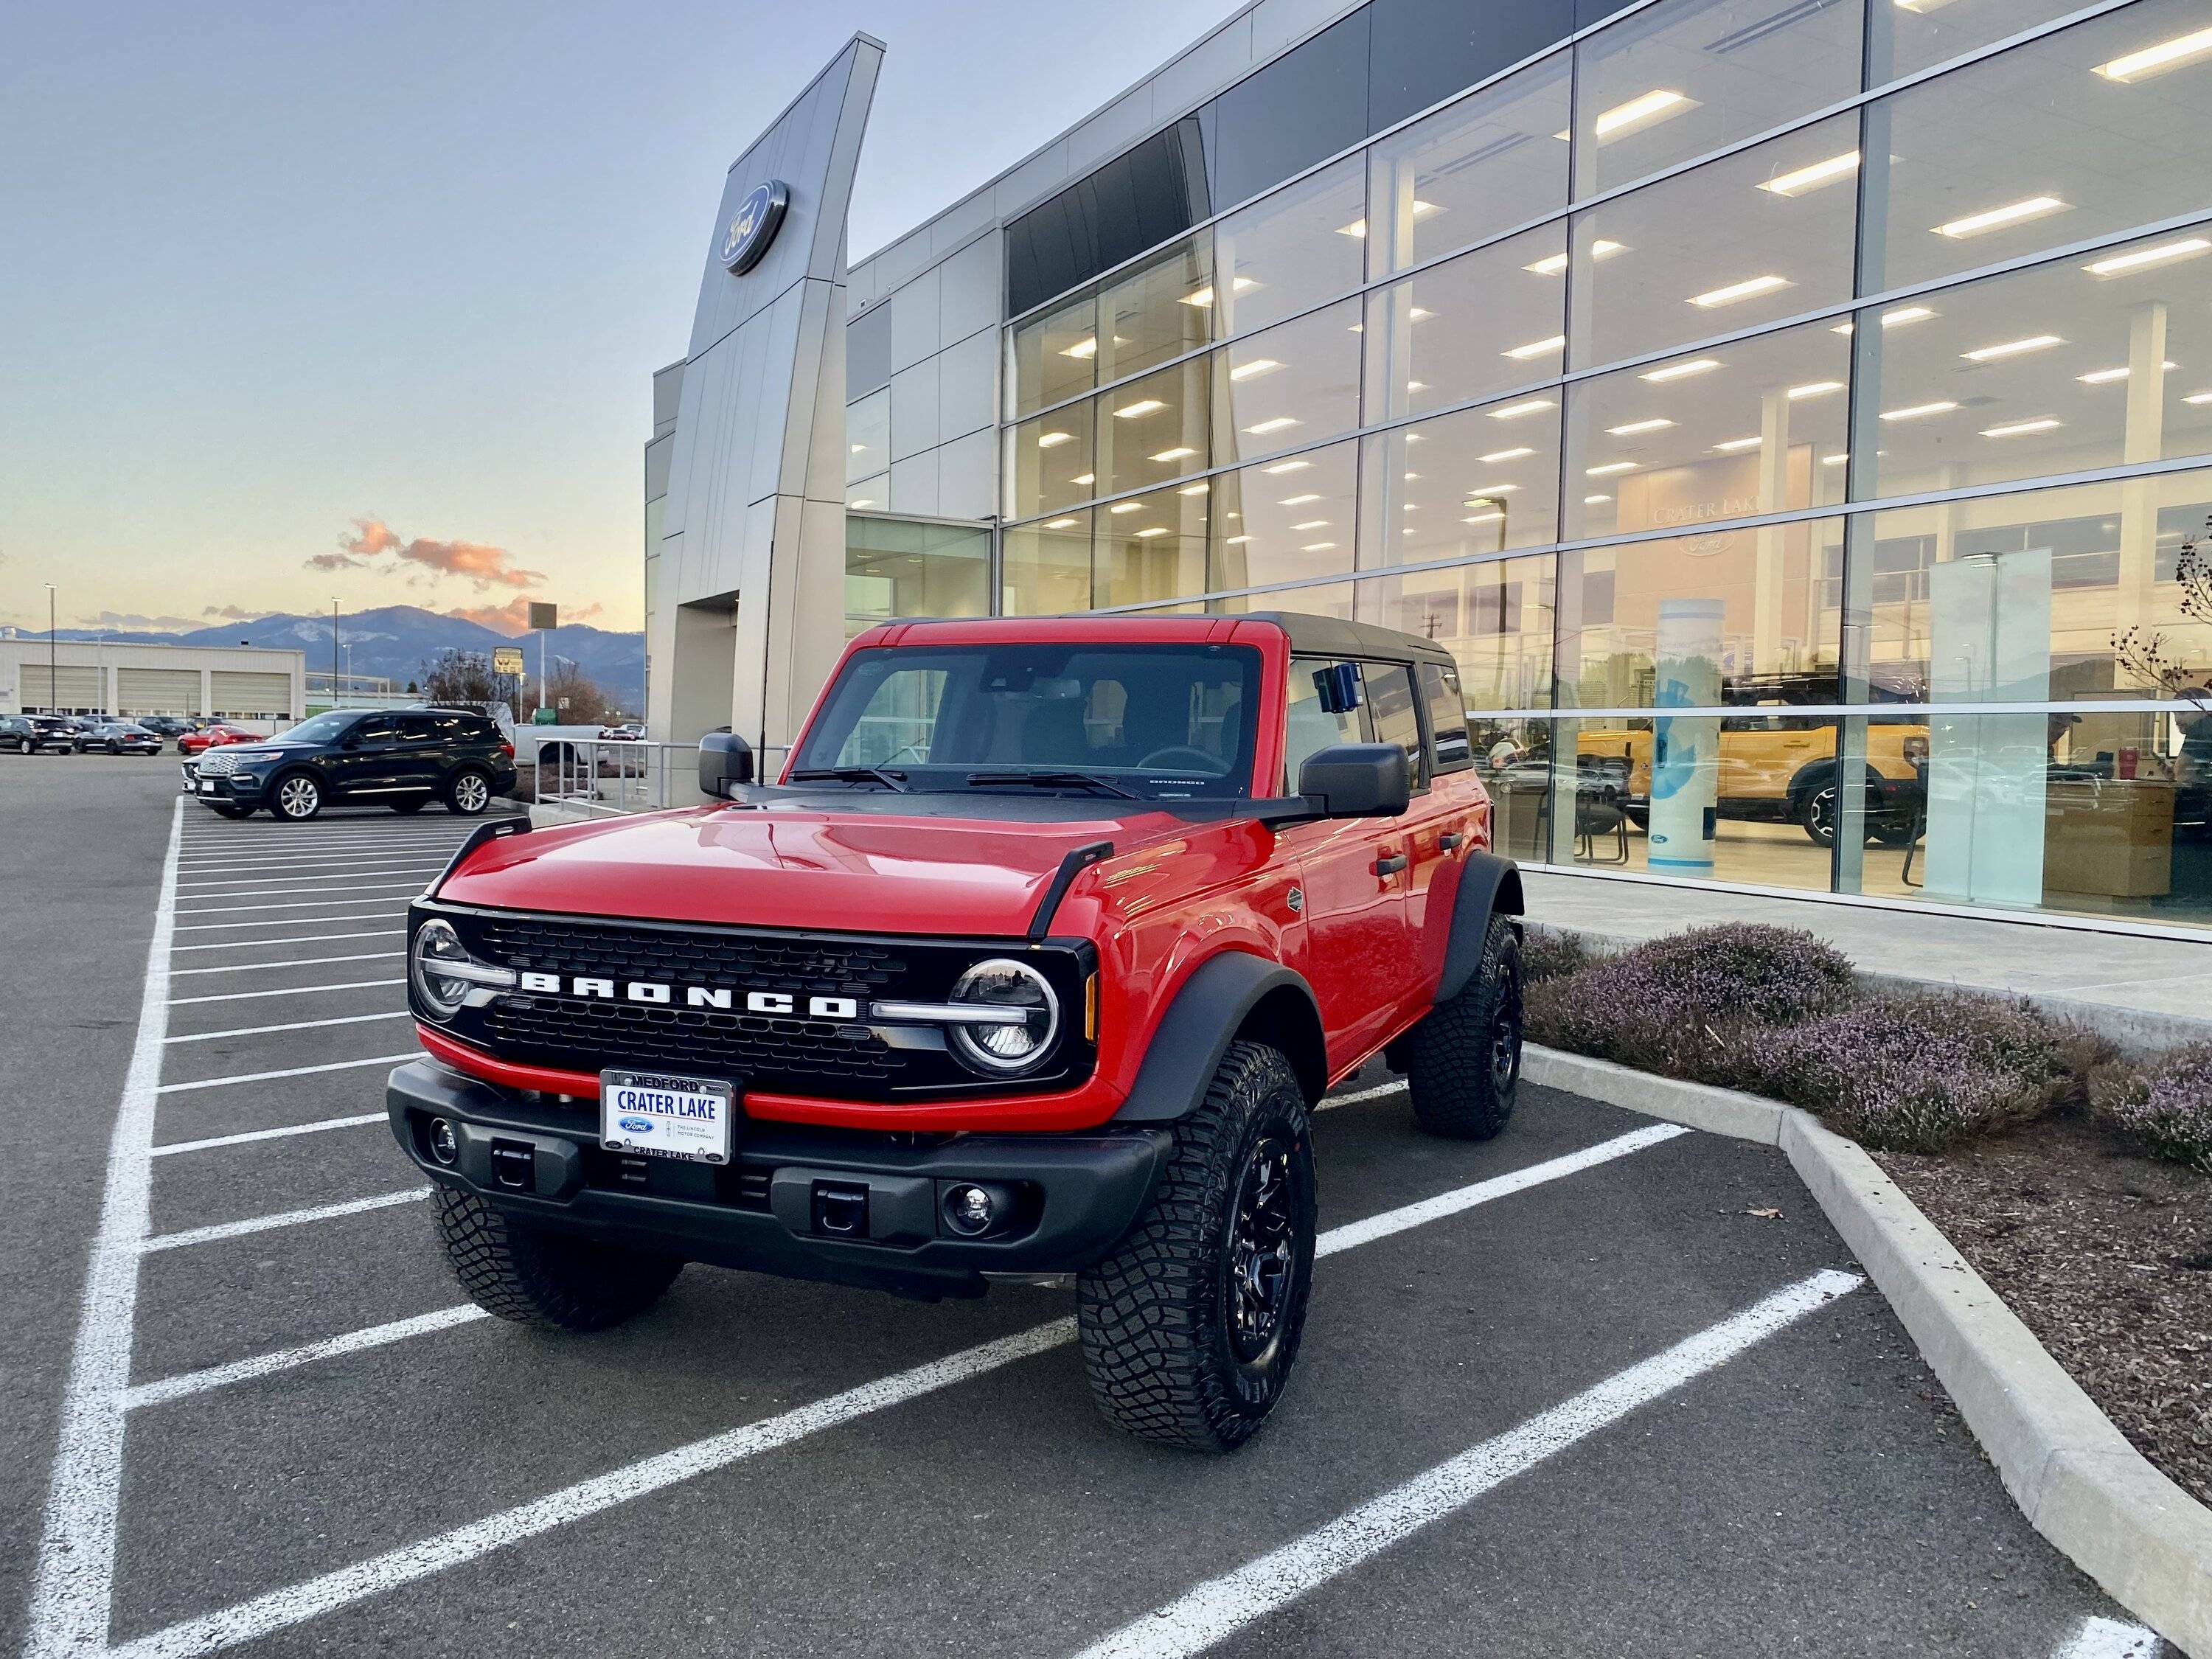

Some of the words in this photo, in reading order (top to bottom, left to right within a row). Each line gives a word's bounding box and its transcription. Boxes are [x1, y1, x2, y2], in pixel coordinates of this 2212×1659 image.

[724, 200, 759, 256] Ford
[1653, 502, 1717, 524] CRATER
[521, 972, 857, 1018] BRONCO
[631, 1074, 699, 1092] MEDFORD
[617, 1091, 674, 1115] CRATER
[678, 1096, 715, 1119] LAKE
[633, 1147, 668, 1158] CRATER
[670, 1151, 694, 1161] LAKE
